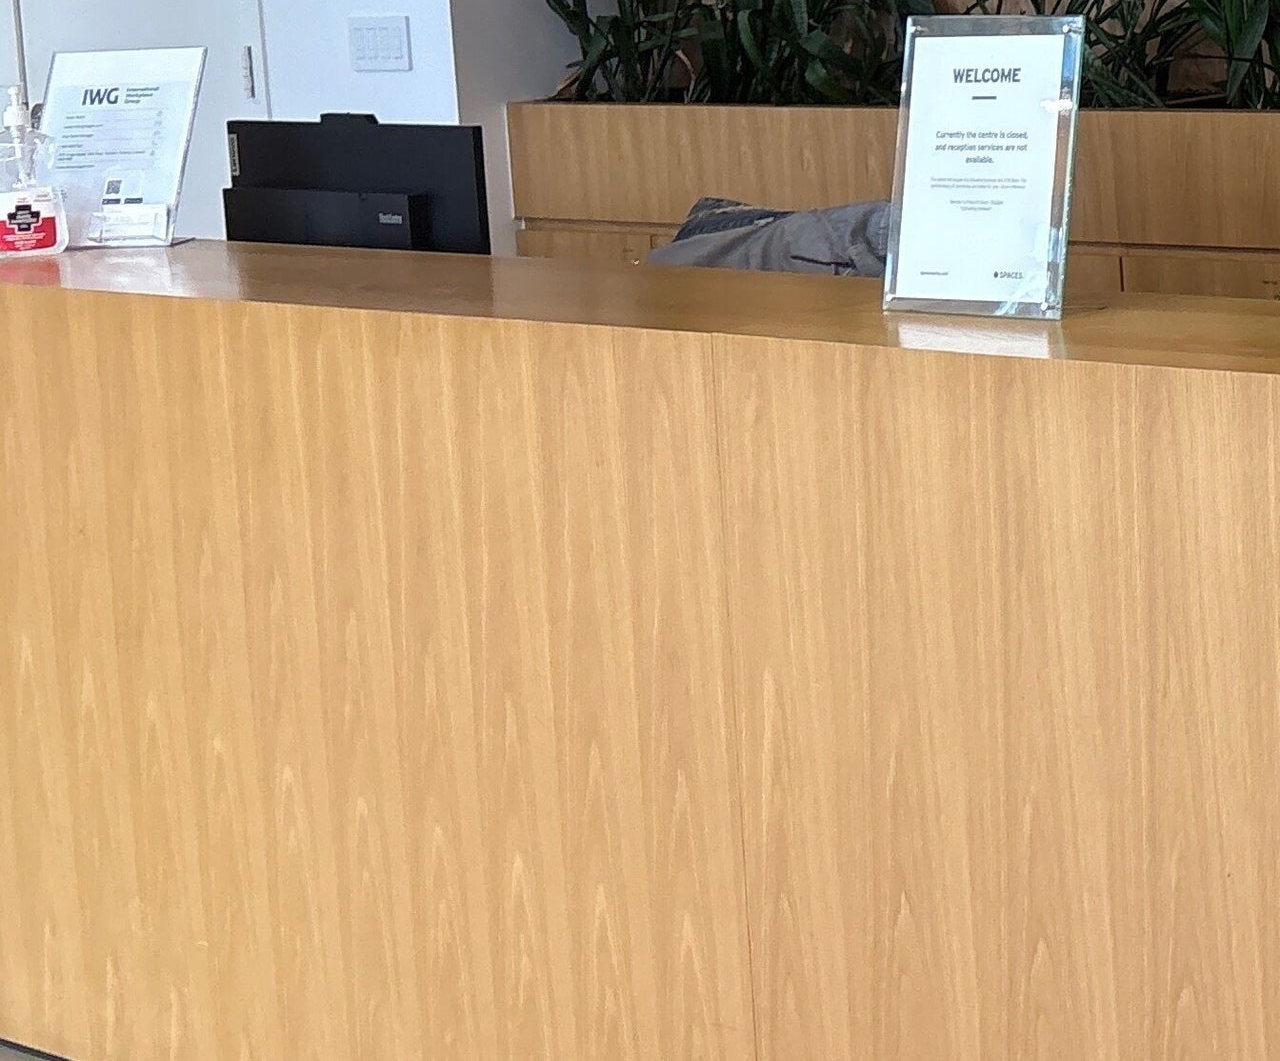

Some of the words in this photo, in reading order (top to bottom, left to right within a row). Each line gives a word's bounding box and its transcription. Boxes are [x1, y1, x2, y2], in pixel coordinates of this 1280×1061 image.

[953, 67, 1021, 83] WELCOME
[82, 87, 119, 106] IWG
[936, 130, 965, 140] Currently
[966, 131, 977, 139] the
[978, 131, 998, 139] centre
[999, 131, 1005, 139] is
[935, 143, 947, 151] and
[977, 143, 1004, 151] services
[1016, 143, 1028, 151] not
